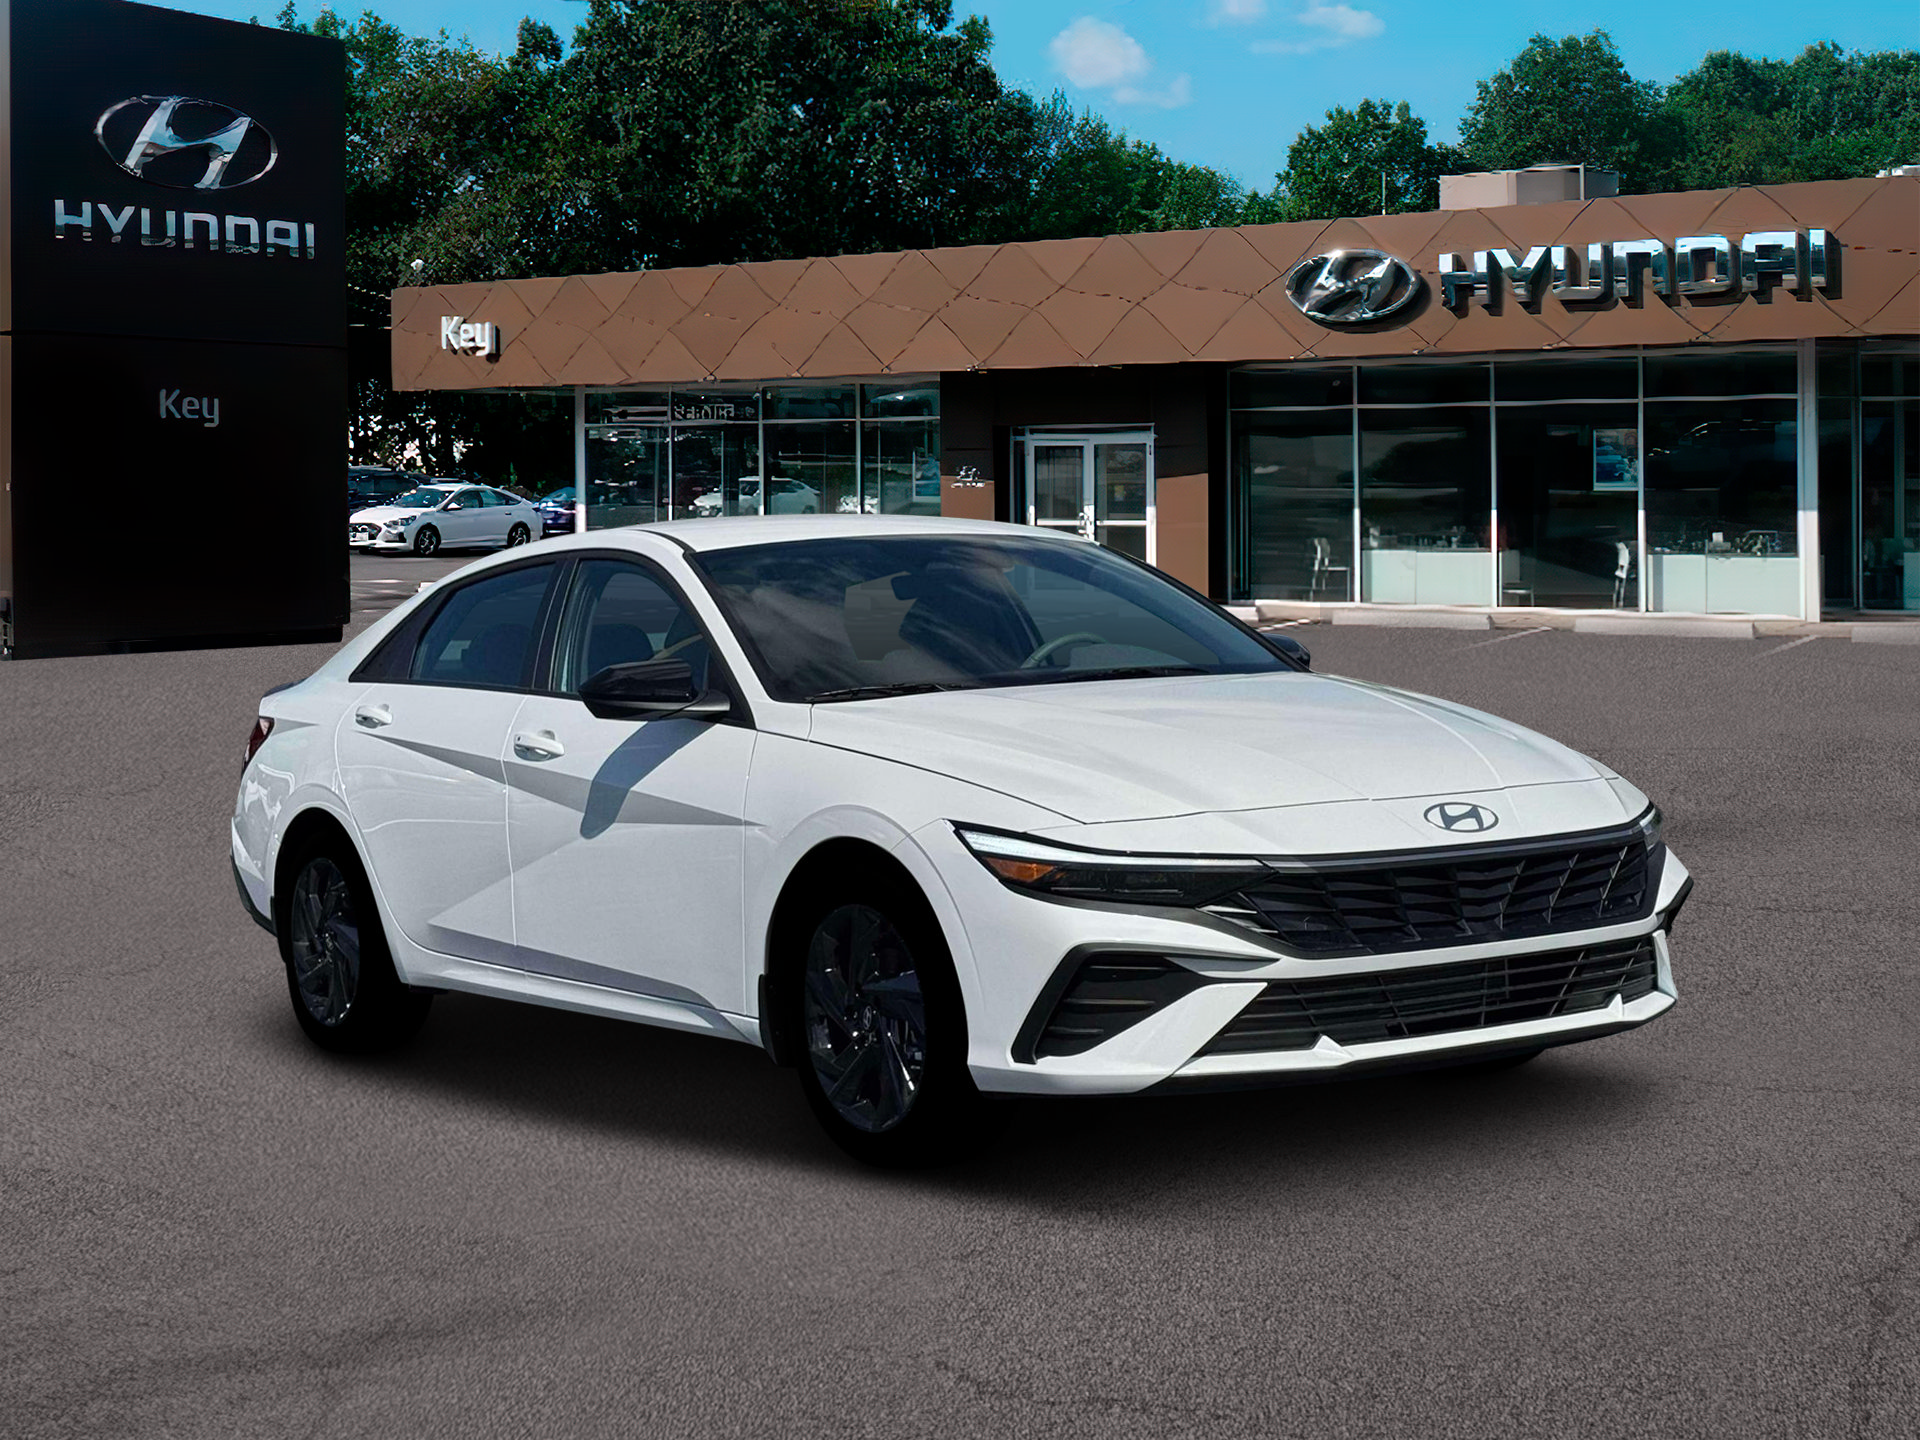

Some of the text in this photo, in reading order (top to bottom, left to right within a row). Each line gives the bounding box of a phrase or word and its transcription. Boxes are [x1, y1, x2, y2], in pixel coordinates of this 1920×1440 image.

[54, 199, 316, 260] HYUNDAI
[1438, 228, 1838, 310] HYUNDAI
[441, 315, 493, 357] Key
[158, 388, 220, 428] Key
